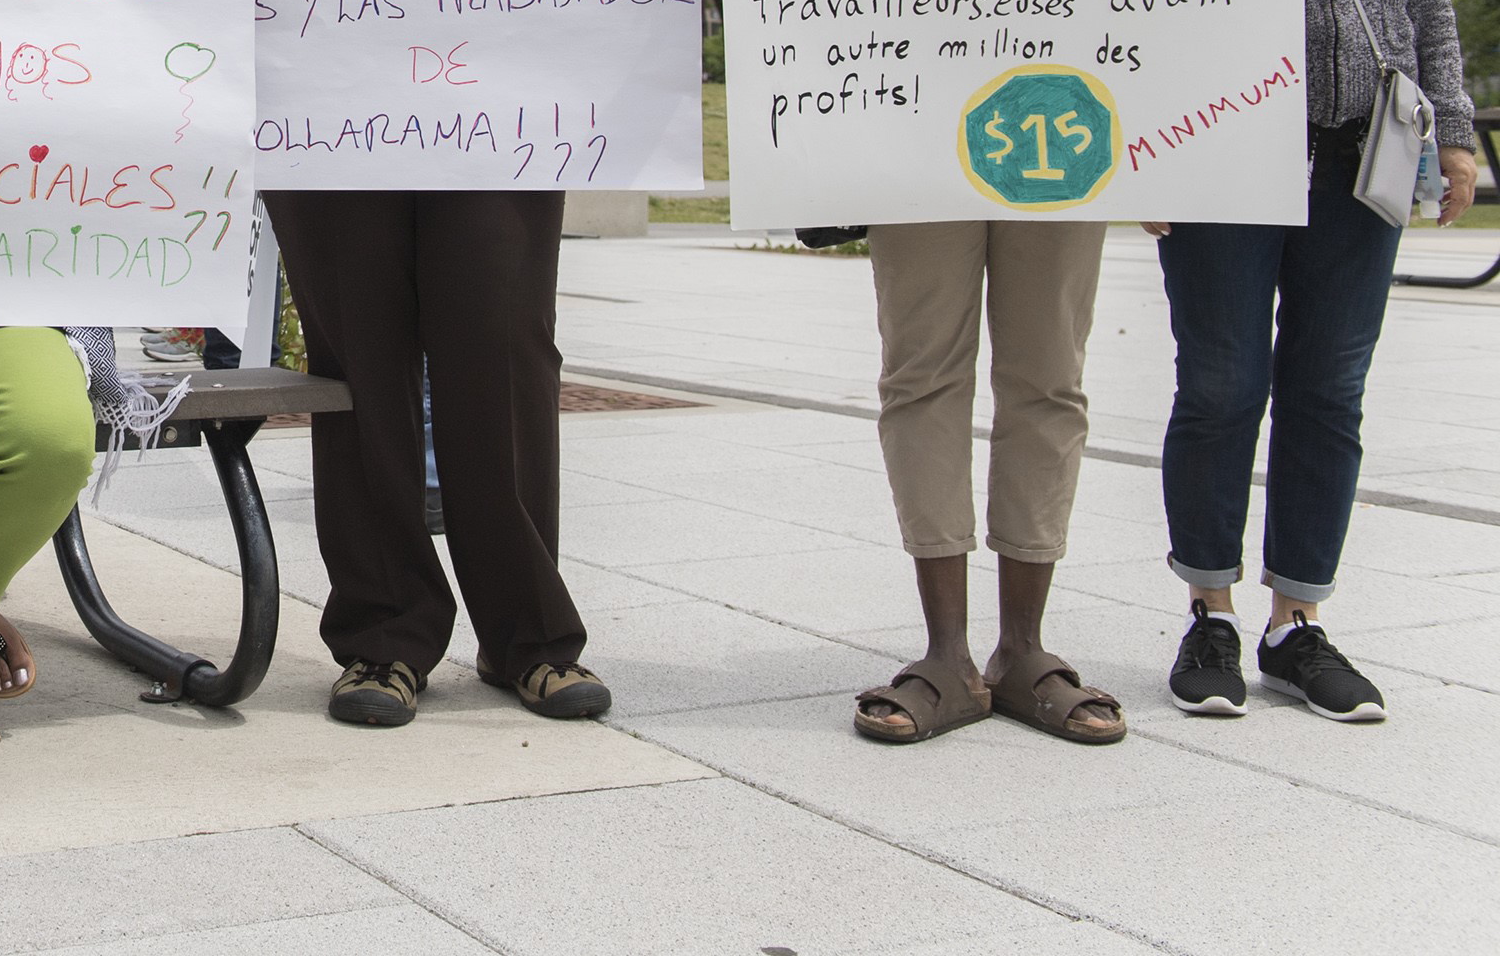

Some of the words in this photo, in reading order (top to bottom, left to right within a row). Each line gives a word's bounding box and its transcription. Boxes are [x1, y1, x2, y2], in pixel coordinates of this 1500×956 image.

[408, 41, 479, 86] DE
[762, 42, 797, 67] un
[827, 31, 911, 66] autre
[938, 28, 1055, 59] million
[1096, 33, 1142, 73] des
[771, 74, 921, 148] profits!
[984, 109, 1094, 181] $15
[1127, 56, 1302, 172] MINIMUM!
